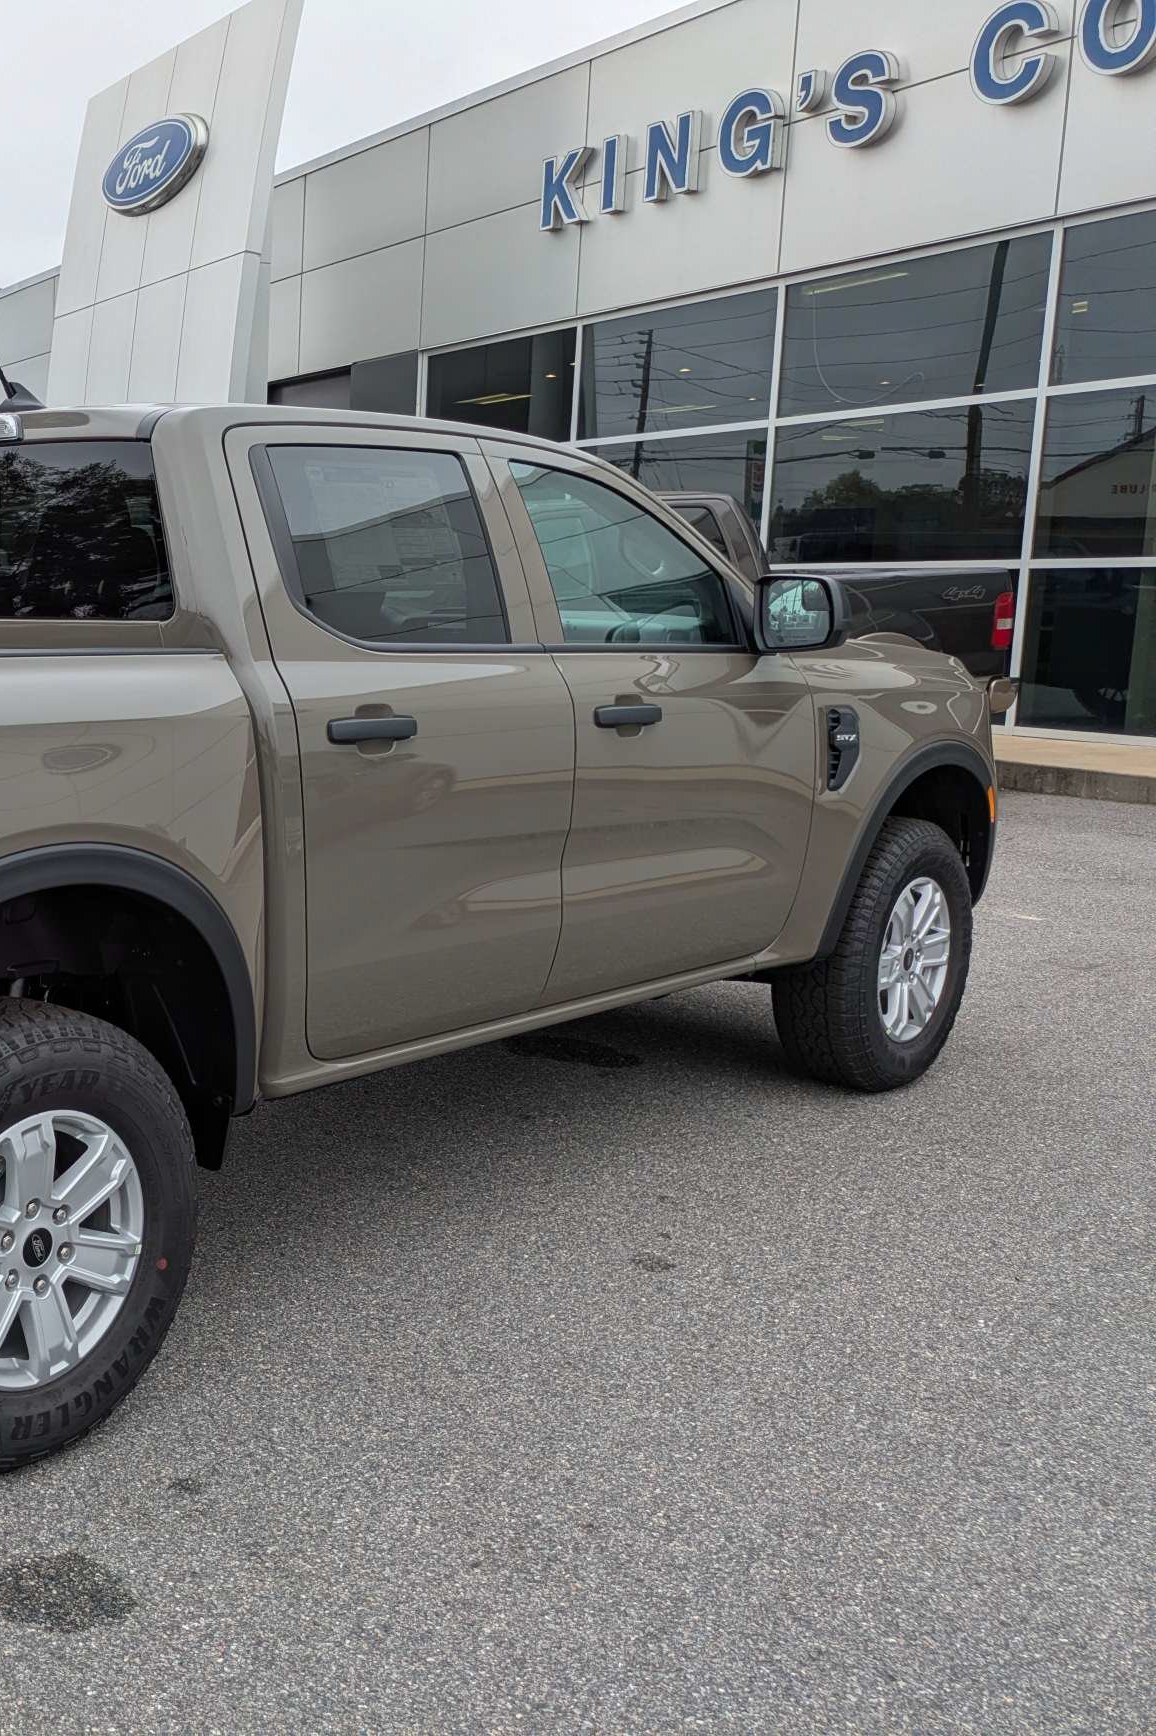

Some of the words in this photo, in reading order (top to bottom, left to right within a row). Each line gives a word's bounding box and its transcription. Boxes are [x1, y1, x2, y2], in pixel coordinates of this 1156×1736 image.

[115, 136, 172, 195] Ford
[540, 49, 899, 232] KING'S
[11, 1296, 168, 1441] WRANGLER
